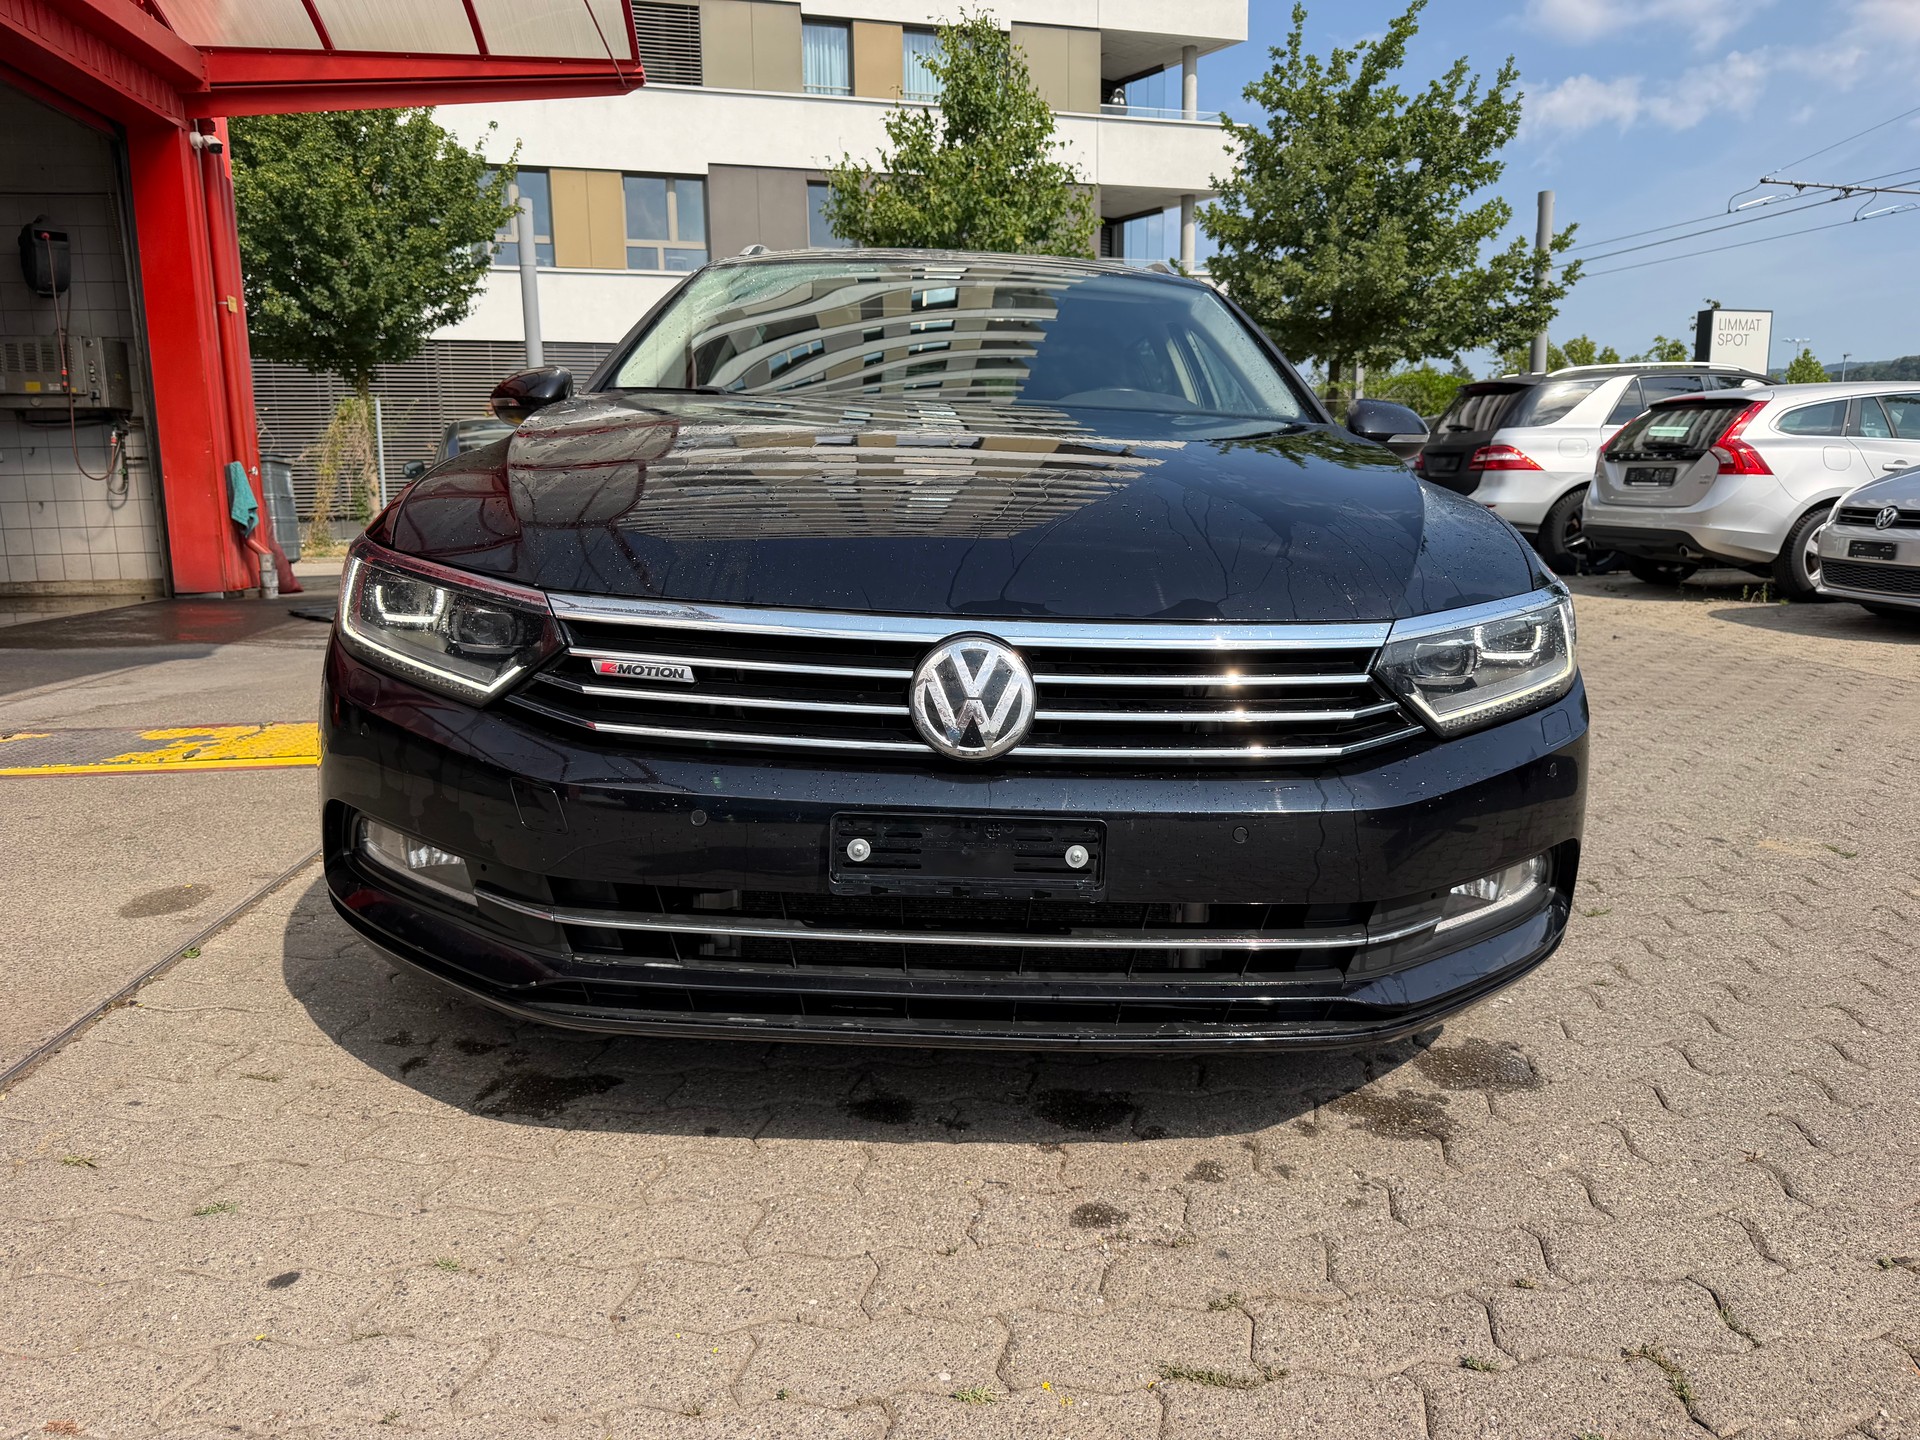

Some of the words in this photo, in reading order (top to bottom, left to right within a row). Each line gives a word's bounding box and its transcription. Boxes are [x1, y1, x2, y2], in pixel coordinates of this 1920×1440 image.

[1718, 318, 1762, 332] LIMMAT
[1717, 333, 1750, 347] SPOT
[606, 662, 685, 679] 4MOTION
[922, 642, 1026, 753] VW
